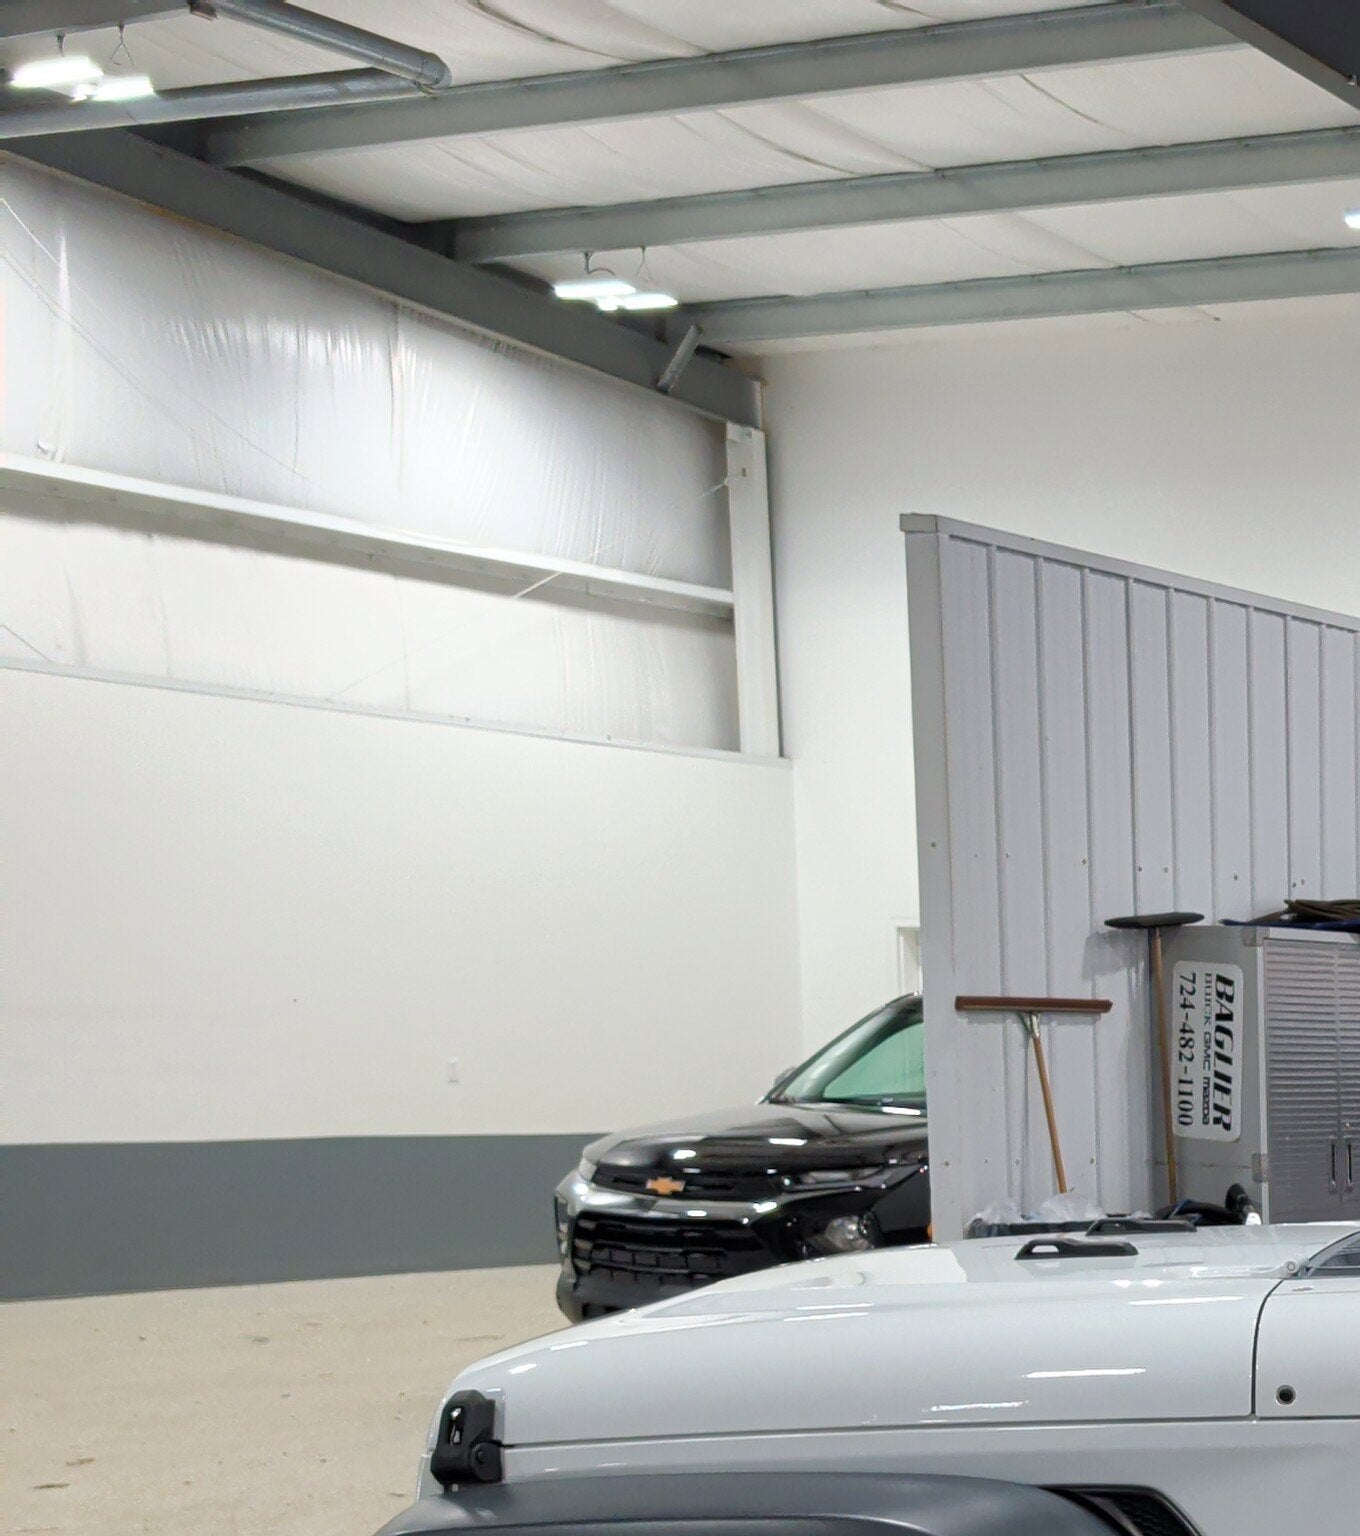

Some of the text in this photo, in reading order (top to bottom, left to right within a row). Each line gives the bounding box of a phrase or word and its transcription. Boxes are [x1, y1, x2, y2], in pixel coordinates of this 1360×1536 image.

[1177, 972, 1197, 1126] 724-482-1100
[1203, 972, 1212, 1026] BUICK
[1202, 1032, 1212, 1072] GMC
[1212, 973, 1235, 1132] BAGLIER
